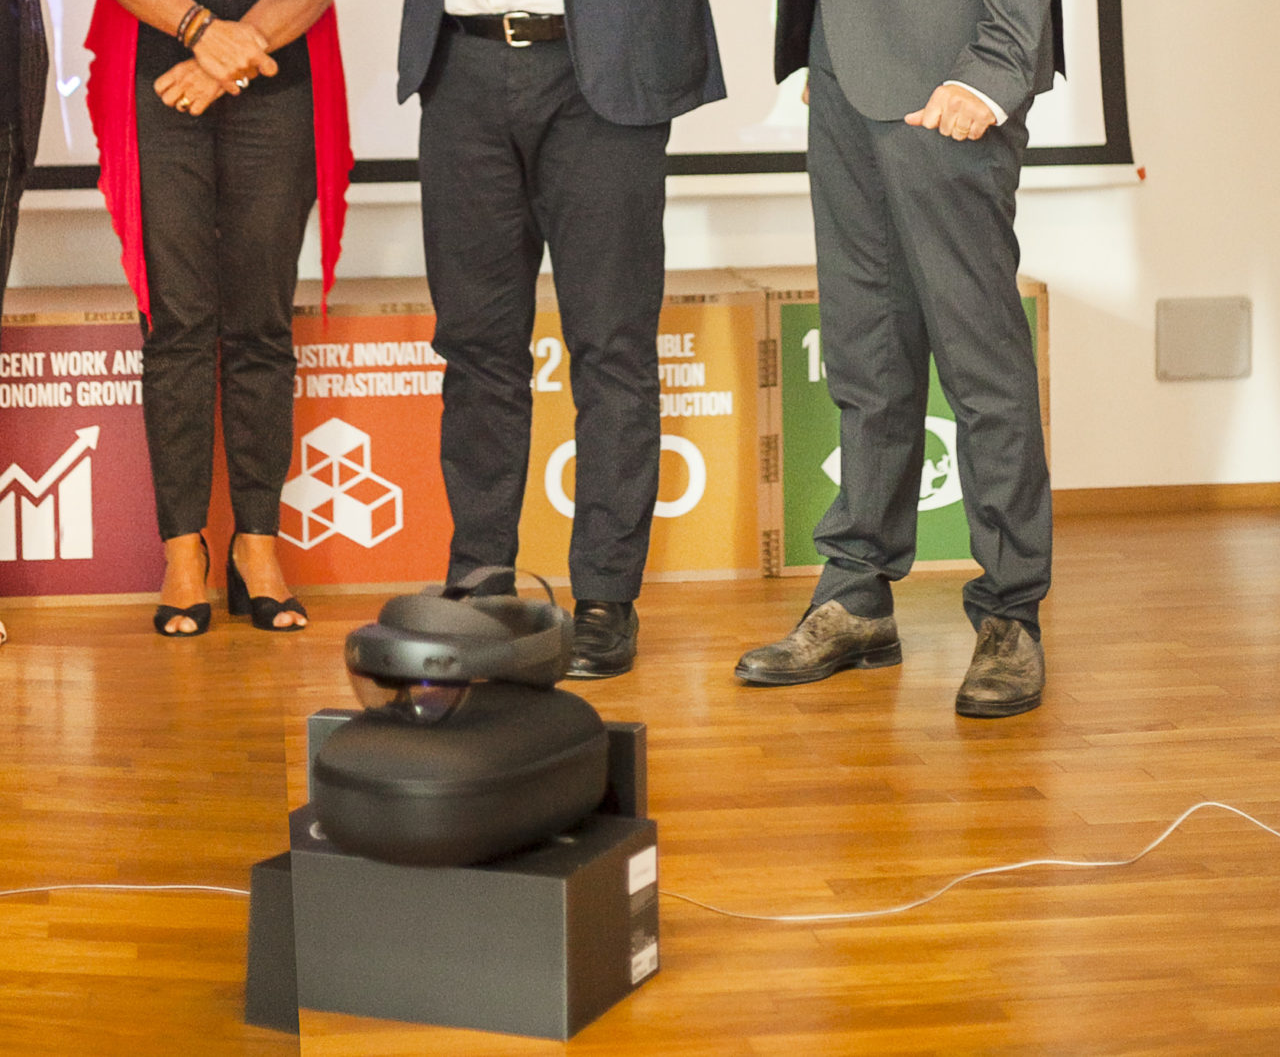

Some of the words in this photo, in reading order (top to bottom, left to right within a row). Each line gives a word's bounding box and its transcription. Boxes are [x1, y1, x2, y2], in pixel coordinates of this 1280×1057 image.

[50, 350, 108, 376] WORK
[294, 343, 352, 369] USTRY,
[529, 337, 562, 392] 2
[802, 328, 827, 382] 1
[76, 380, 143, 406] GROWT
[306, 371, 443, 398] INFRASTRUCTUR
[660, 391, 733, 417] DUCTION
